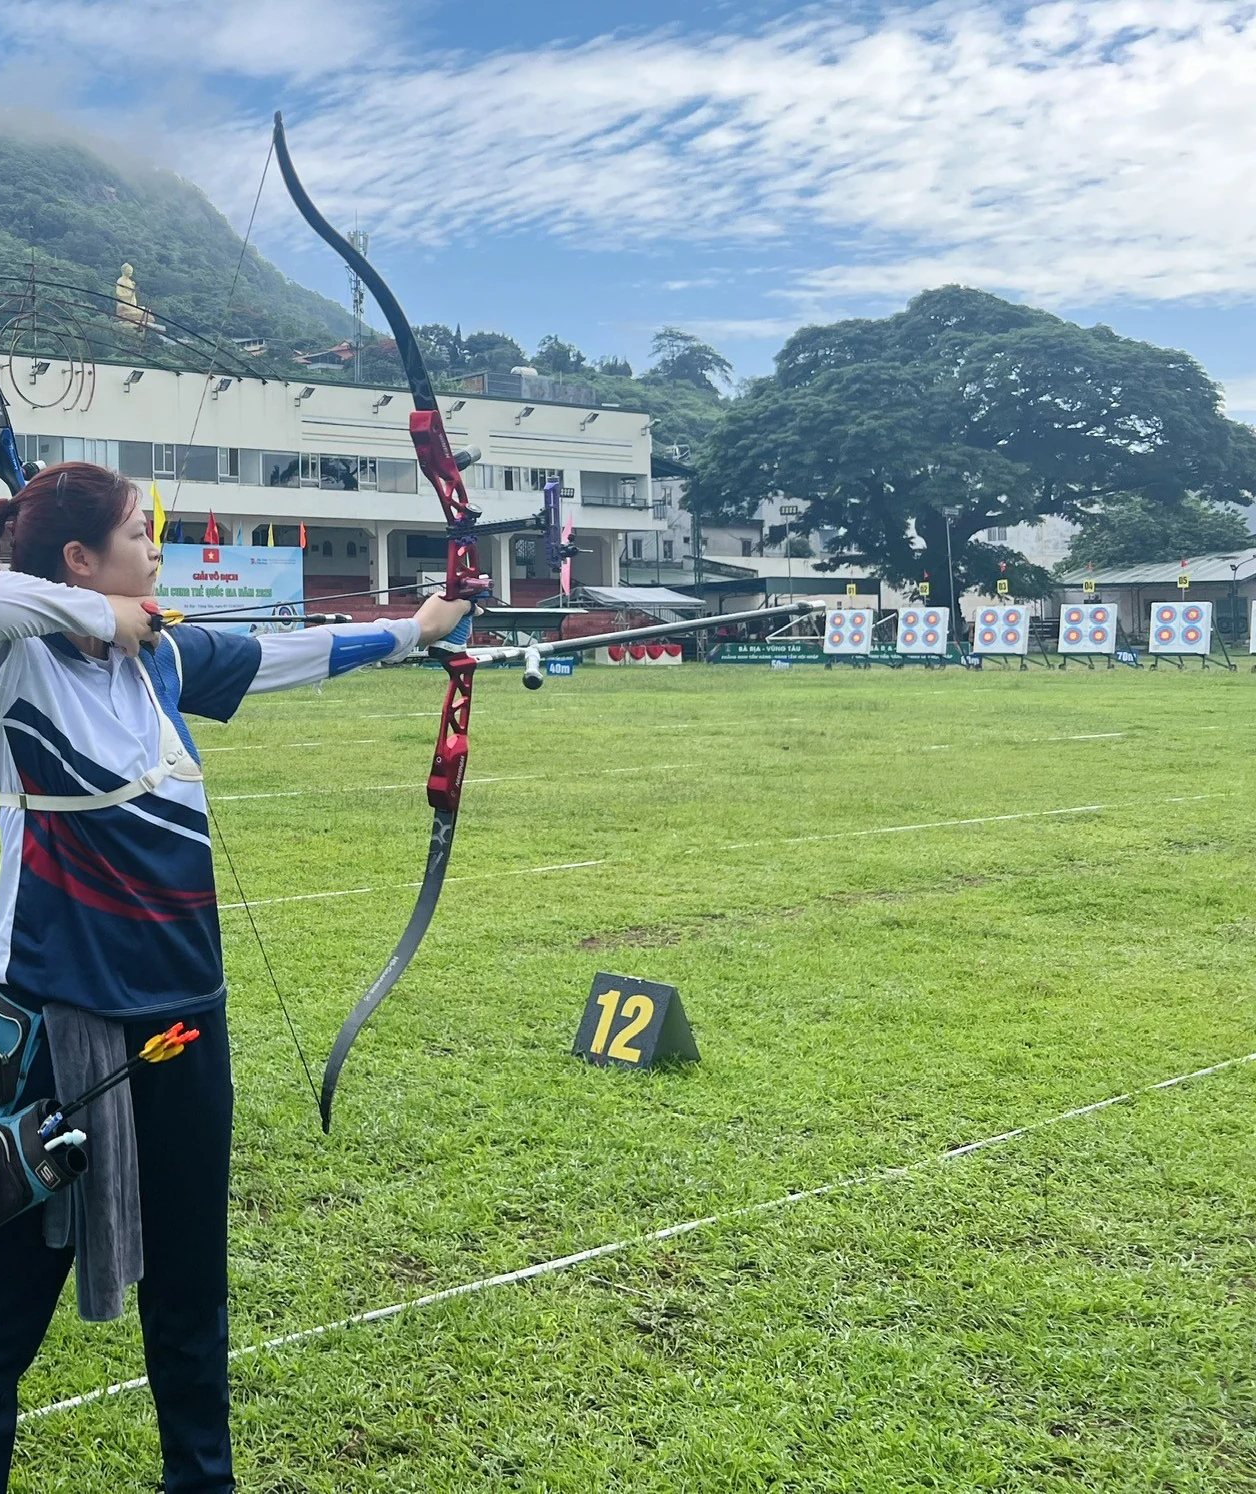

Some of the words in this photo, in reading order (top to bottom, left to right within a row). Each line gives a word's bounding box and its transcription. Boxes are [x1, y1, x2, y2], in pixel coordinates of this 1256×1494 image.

[1178, 576, 1187, 585] 05
[848, 586, 855, 594] 01
[920, 584, 928, 593] 02
[998, 582, 1007, 591] 03
[1084, 581, 1093, 590] 04
[170, 587, 190, 597] CUNG
[205, 584, 224, 598] QUỐC
[225, 587, 237, 597] GIA
[549, 663, 571, 674] 40m
[771, 660, 789, 669] 50m
[590, 990, 654, 1063] 12
